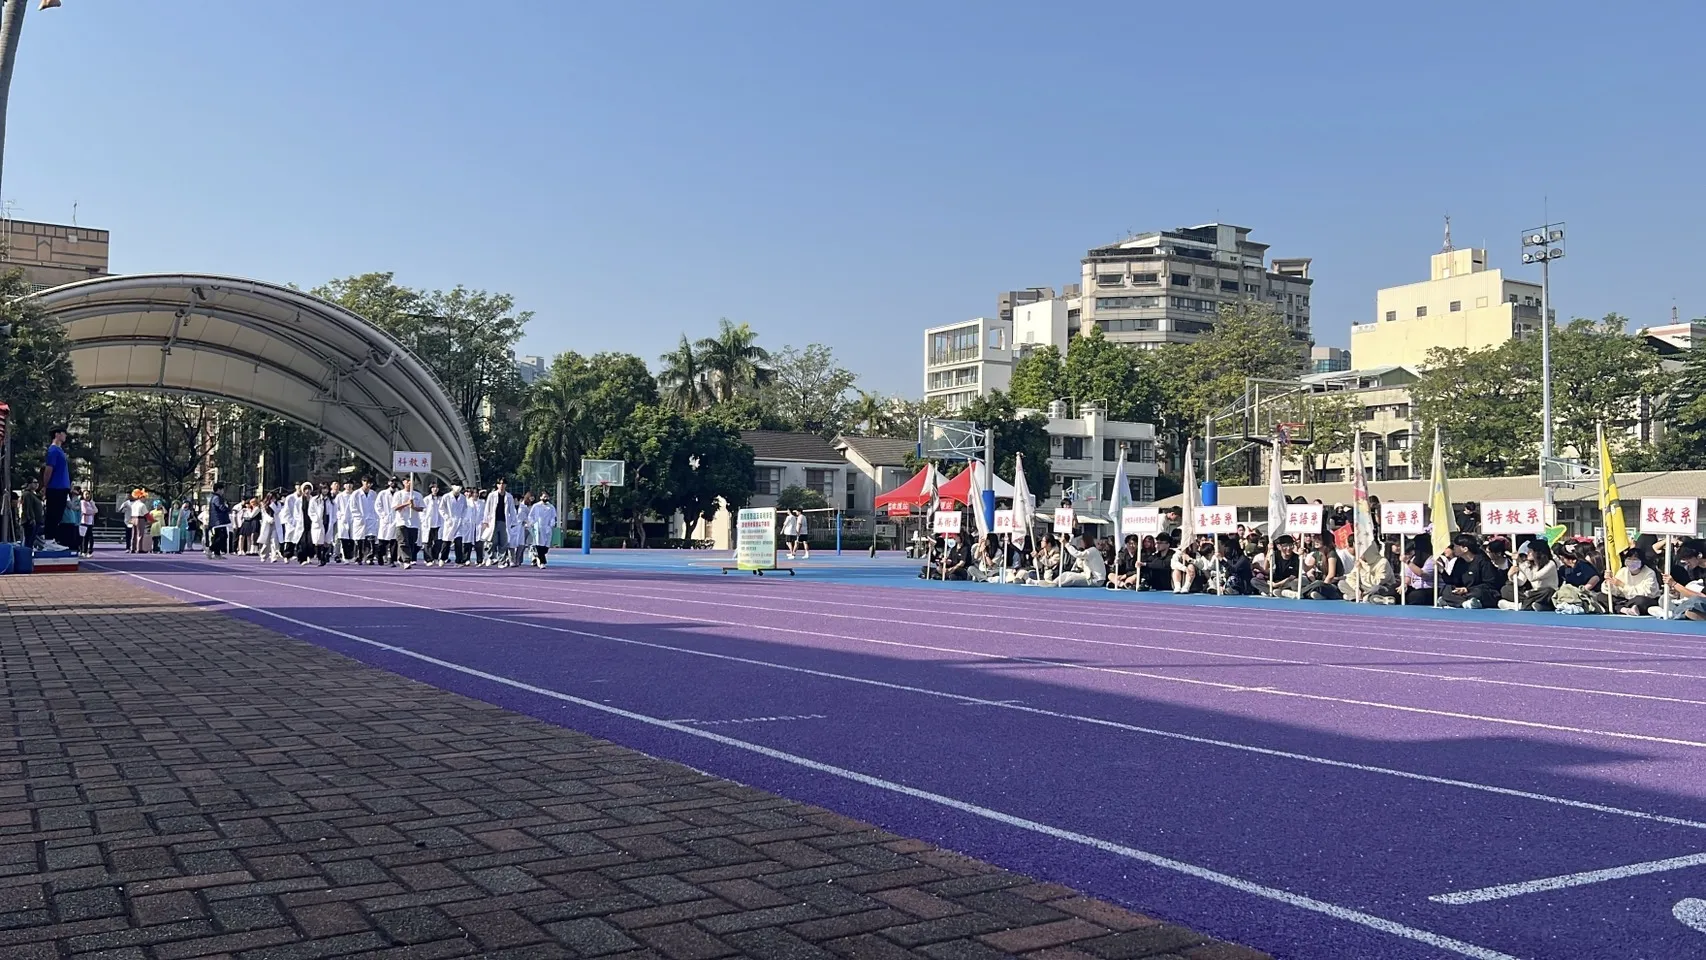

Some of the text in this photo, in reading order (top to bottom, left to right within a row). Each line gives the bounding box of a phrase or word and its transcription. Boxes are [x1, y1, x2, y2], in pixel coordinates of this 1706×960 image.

[398, 457, 429, 468] 科教系
[937, 516, 959, 528] 美術系
[1198, 512, 1233, 527] 臺語系
[1289, 512, 1318, 526] 英語系
[1385, 510, 1419, 525] 音樂系
[1487, 508, 1539, 525] 特教系
[1645, 507, 1691, 525] 數教系
